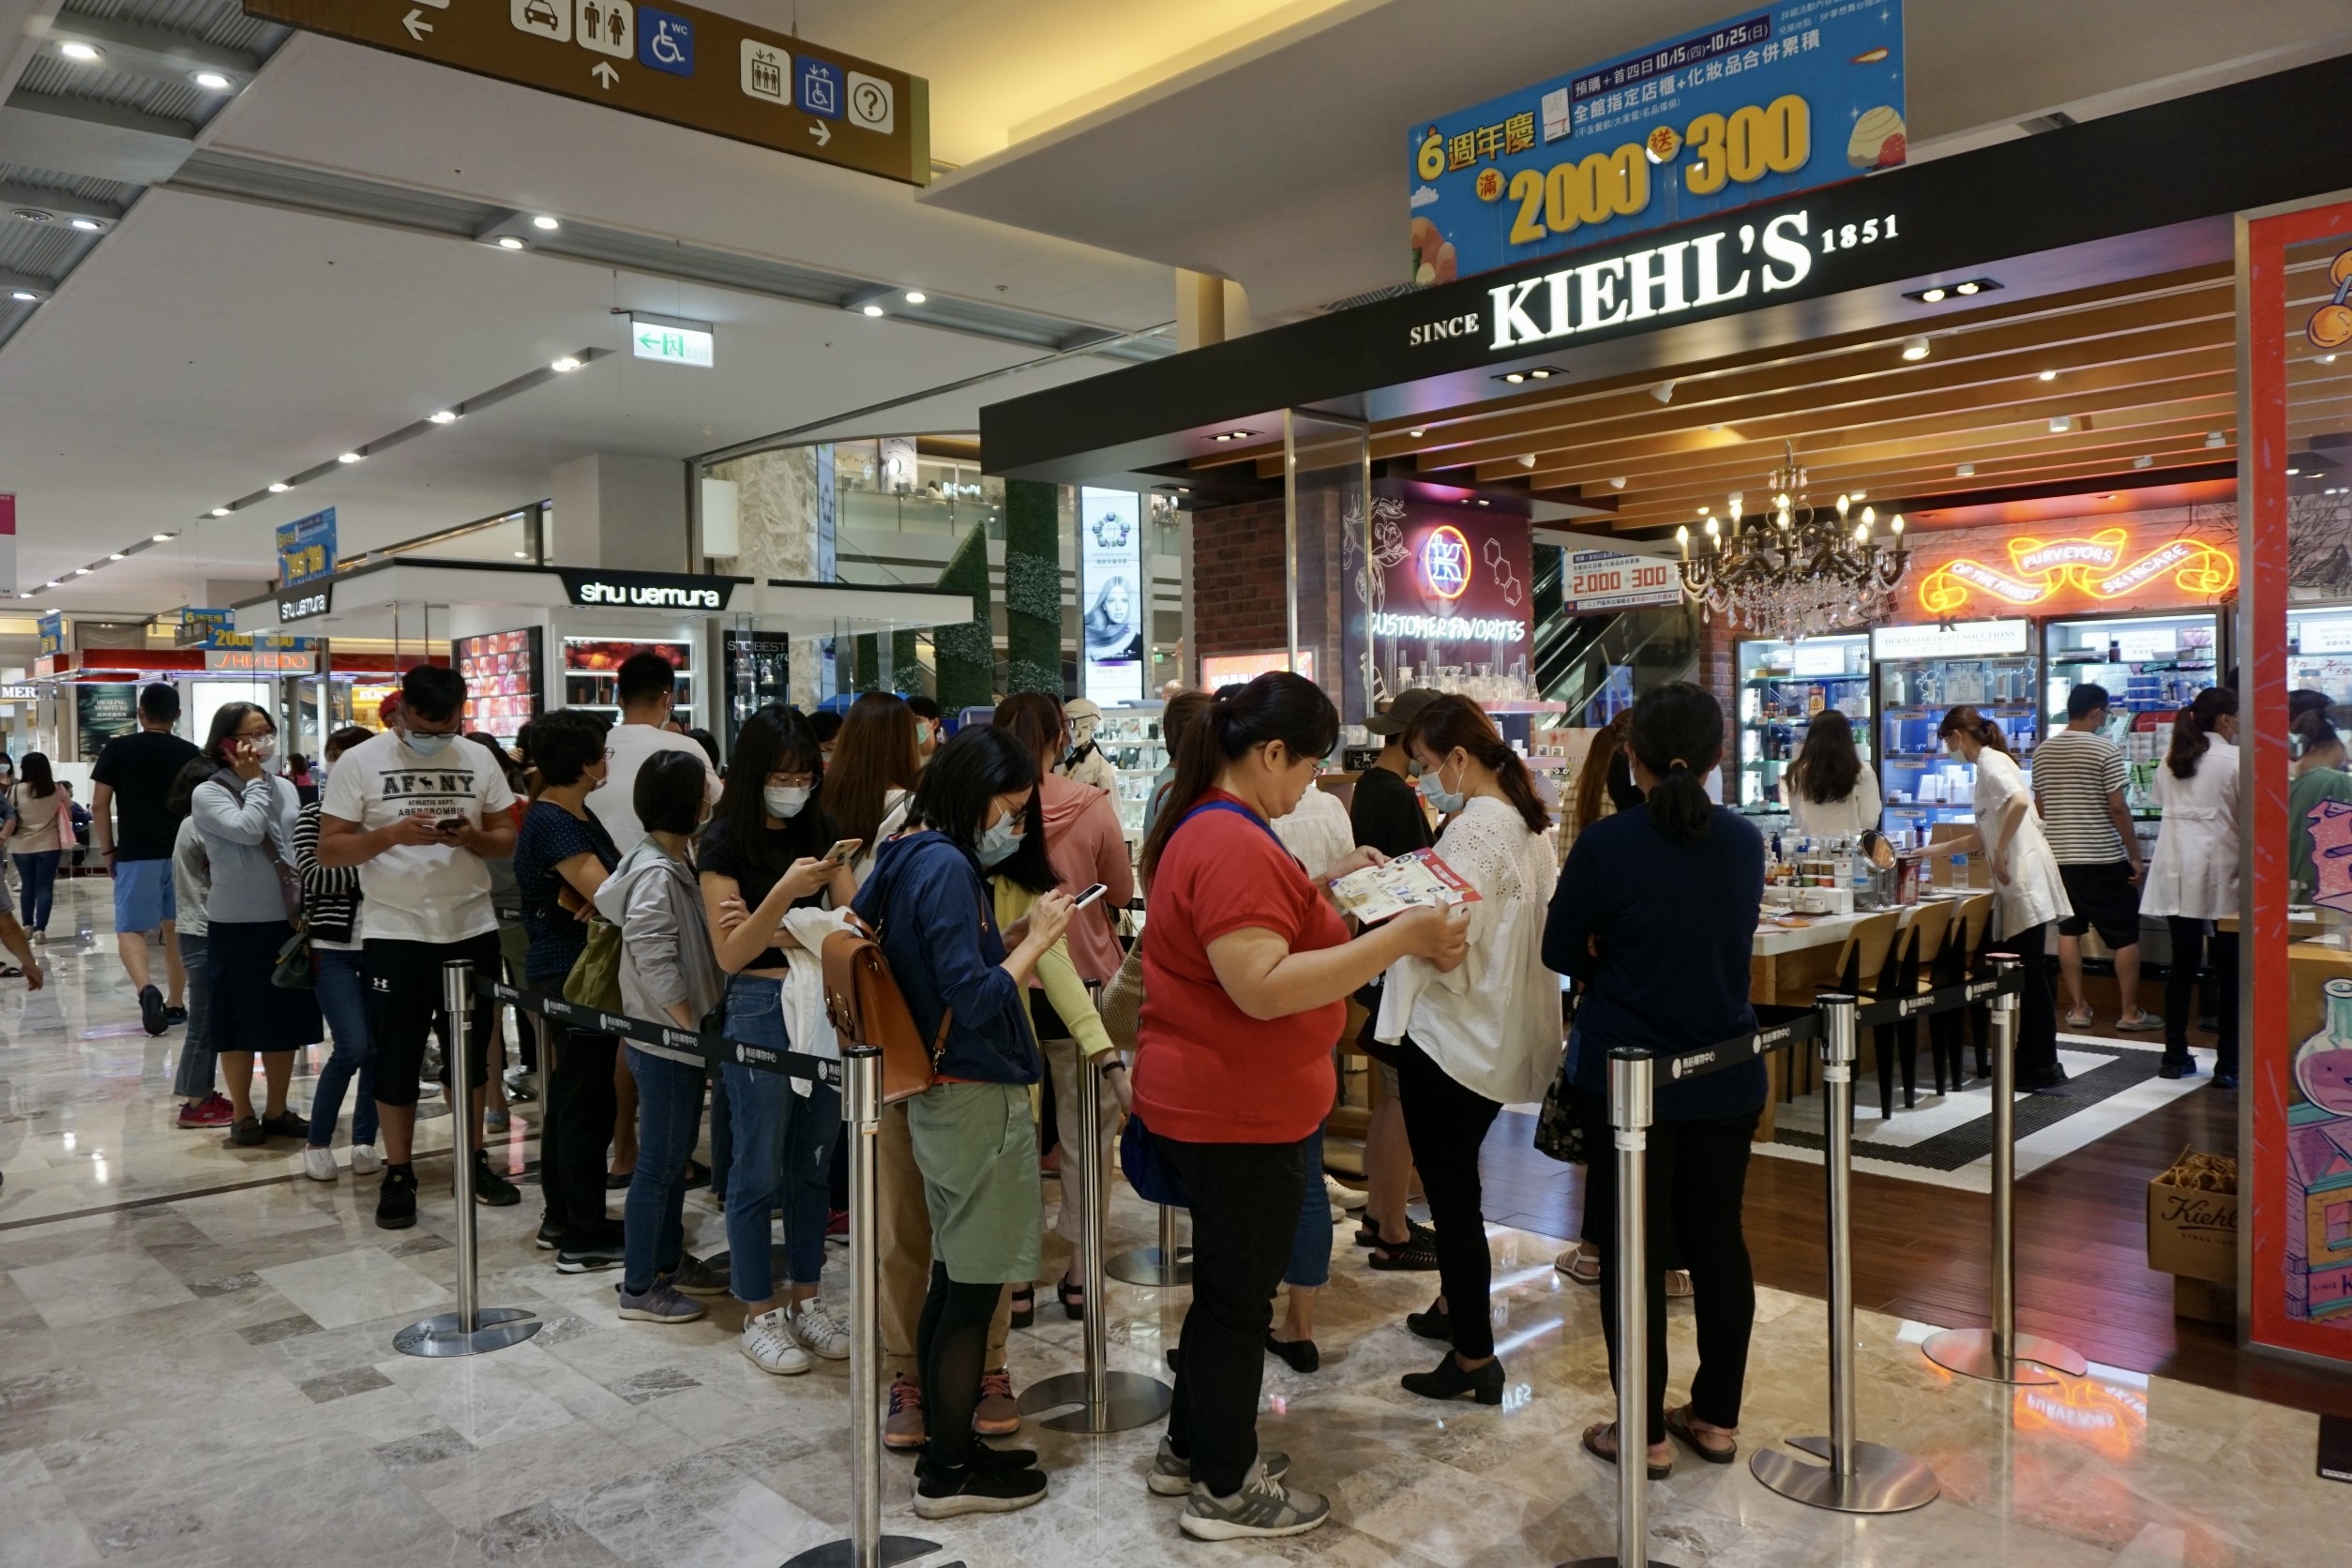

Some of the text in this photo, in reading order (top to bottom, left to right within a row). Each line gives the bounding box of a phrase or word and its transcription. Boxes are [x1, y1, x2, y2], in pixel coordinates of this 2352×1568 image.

[671, 23, 688, 35] WC
[1417, 111, 1535, 181] 6週年慶
[1479, 173, 1498, 197] 滿
[1509, 143, 1650, 245] 2000
[1685, 95, 1810, 194] 300
[1410, 210, 1899, 351] SINCE KIEHL'S 1851
[2022, 545, 2114, 568] PURVEYORS
[2102, 543, 2189, 593] SKINCARE
[1631, 565, 1666, 588] 300
[580, 582, 720, 608] shu uemura
[1449, 616, 1526, 642] FAVORITES
[1885, 630, 2017, 645] DERMATOLOGIST SOLUTIONS
[754, 641, 787, 652] BEST
[214, 653, 309, 669] SHISEIDO
[2, 686, 38, 699] MER
[383, 775, 475, 794] AF NY
